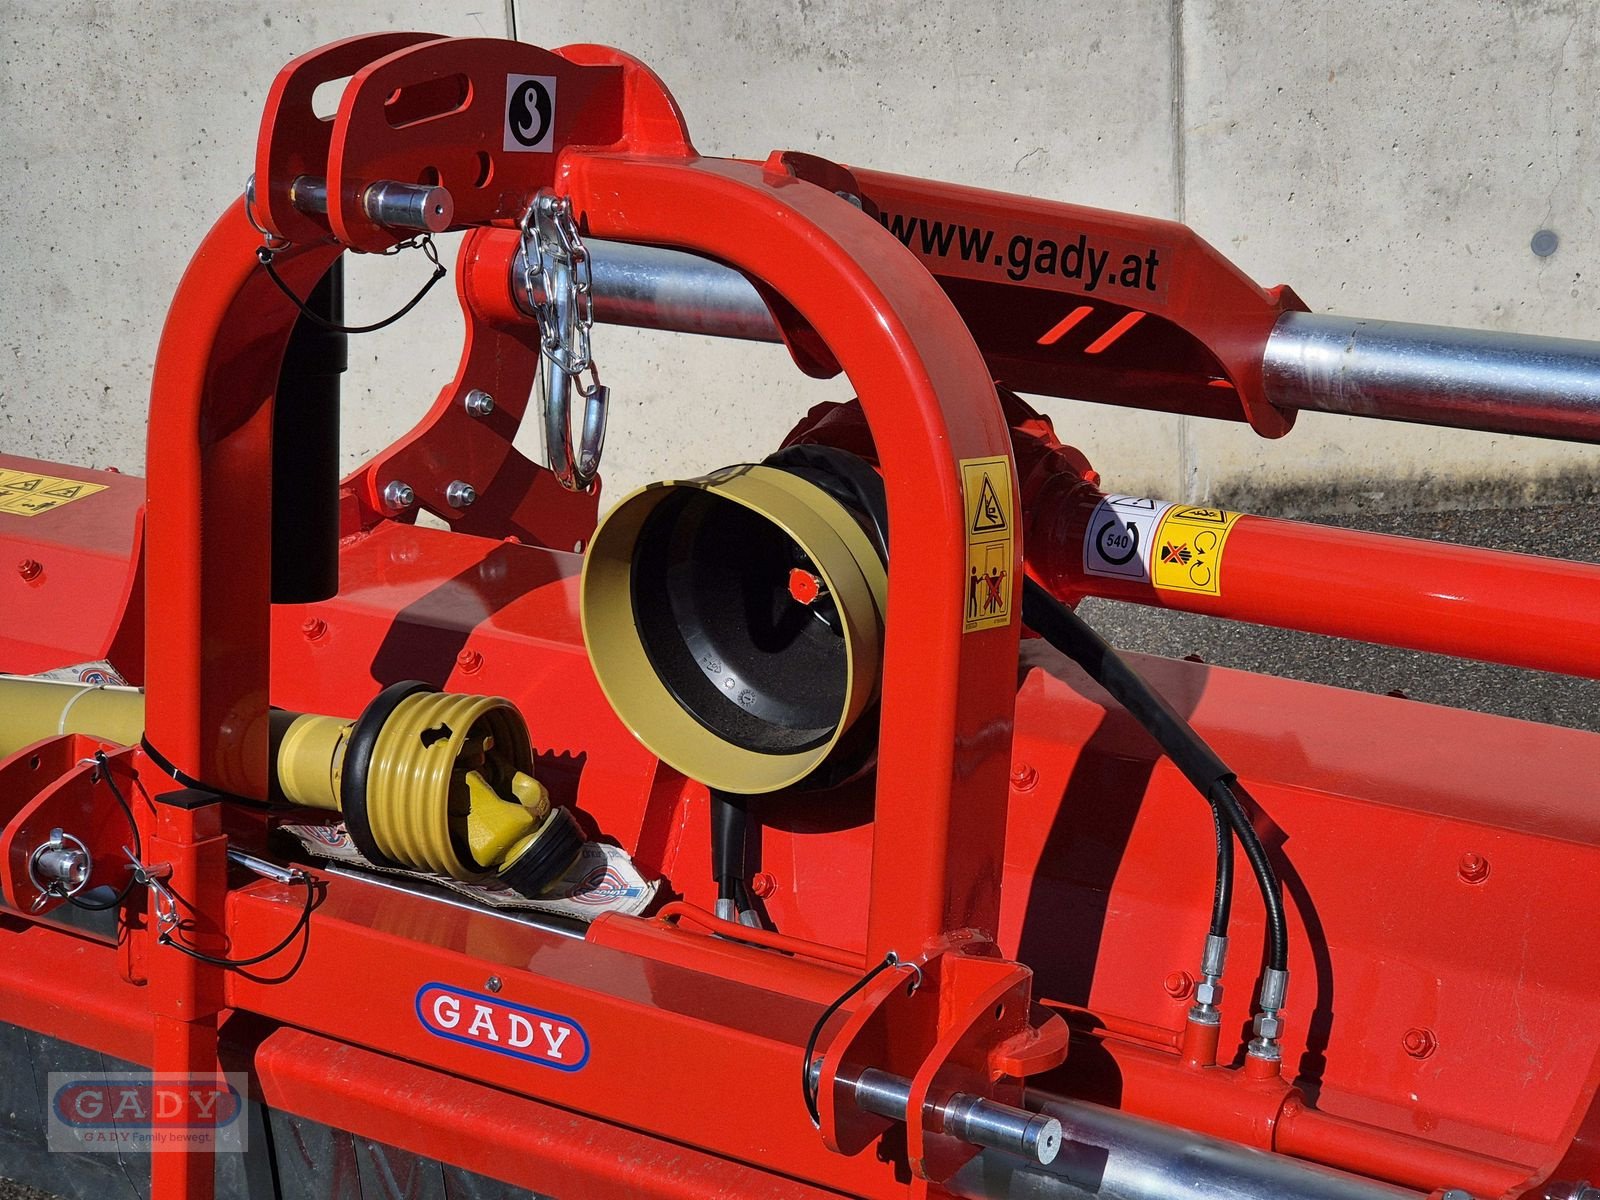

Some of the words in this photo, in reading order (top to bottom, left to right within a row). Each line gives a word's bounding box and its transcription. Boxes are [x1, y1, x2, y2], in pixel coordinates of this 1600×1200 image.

[880, 211, 1160, 292] www.gady.at
[1106, 534, 1129, 549] 540
[433, 995, 571, 1059] GADY
